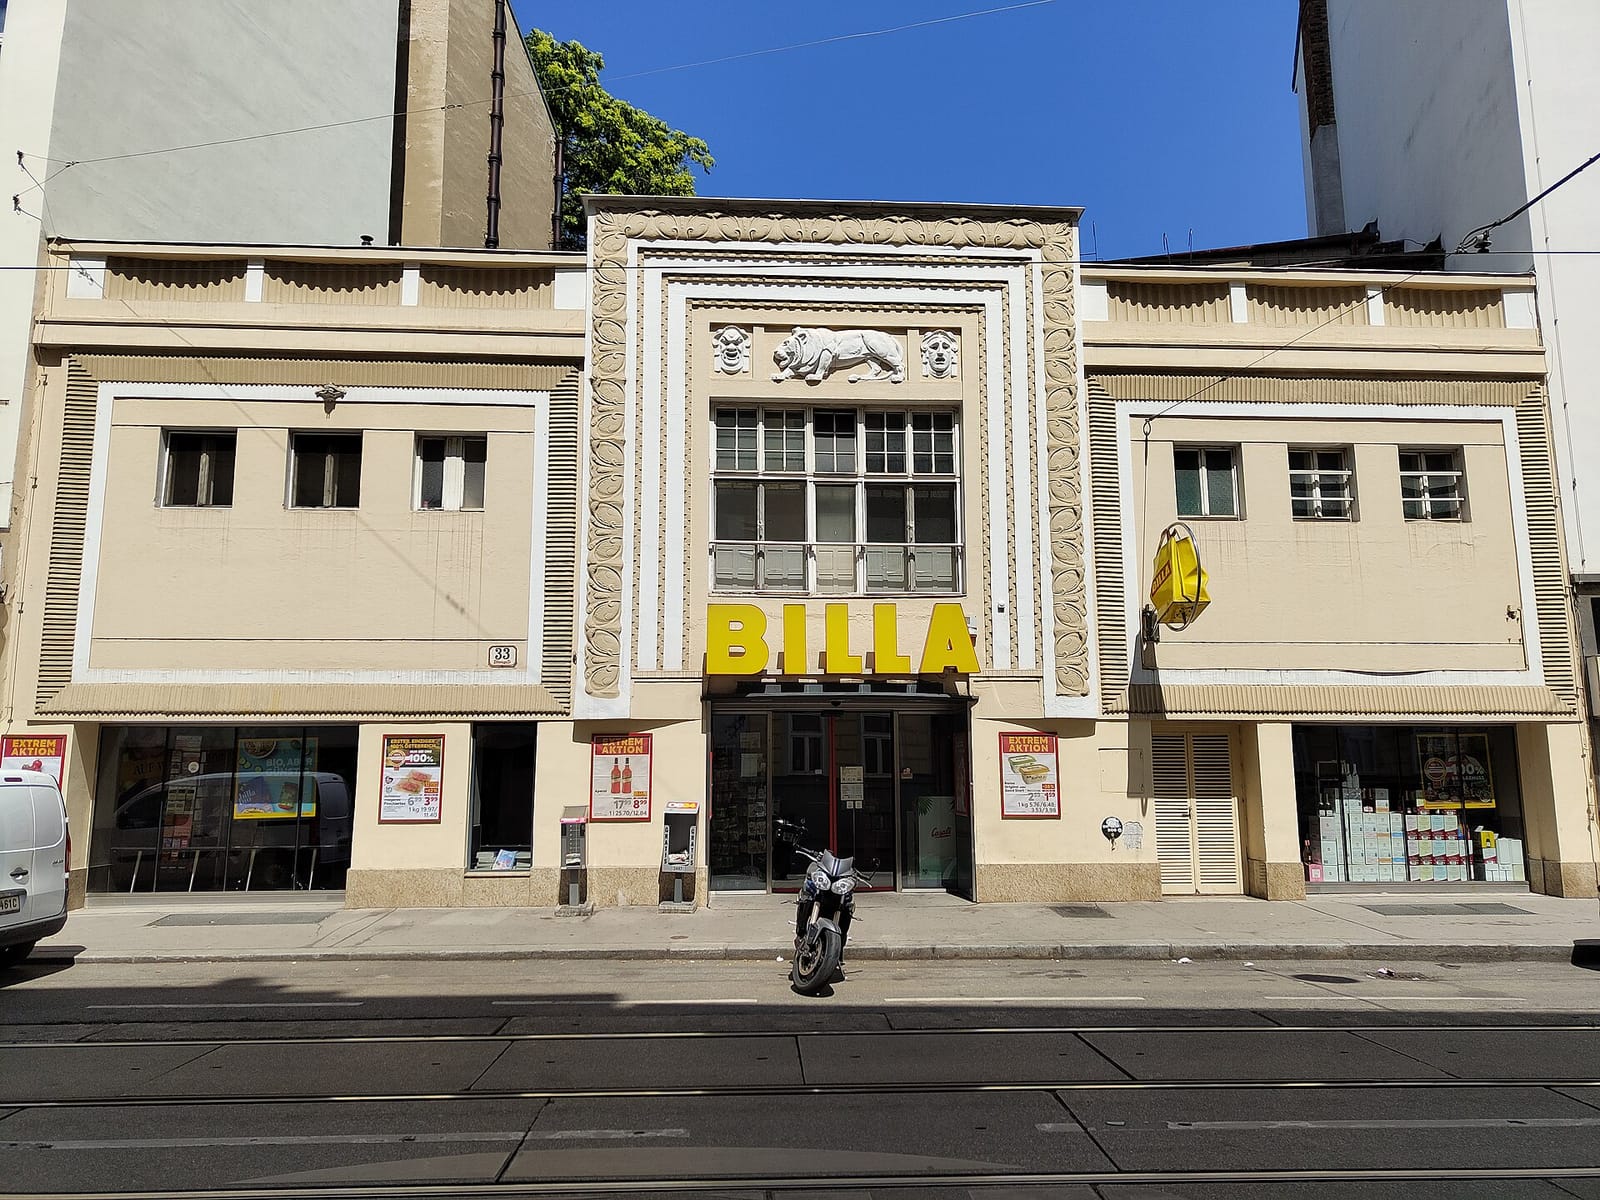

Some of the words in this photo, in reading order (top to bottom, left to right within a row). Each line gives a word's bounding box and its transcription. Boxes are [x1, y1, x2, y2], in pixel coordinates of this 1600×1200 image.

[1151, 562, 1171, 594] BILLA
[706, 603, 981, 675] BILLA
[495, 647, 510, 660] 33
[12, 739, 57, 748] EXTREM
[602, 737, 643, 746] EXTREM
[1008, 736, 1048, 745] EXTREM
[11, 747, 56, 756] AKTION
[601, 745, 643, 754] AKTION
[1008, 744, 1049, 753] AKTION
[286, 758, 313, 767] ABR
[409, 753, 434, 763] 100%
